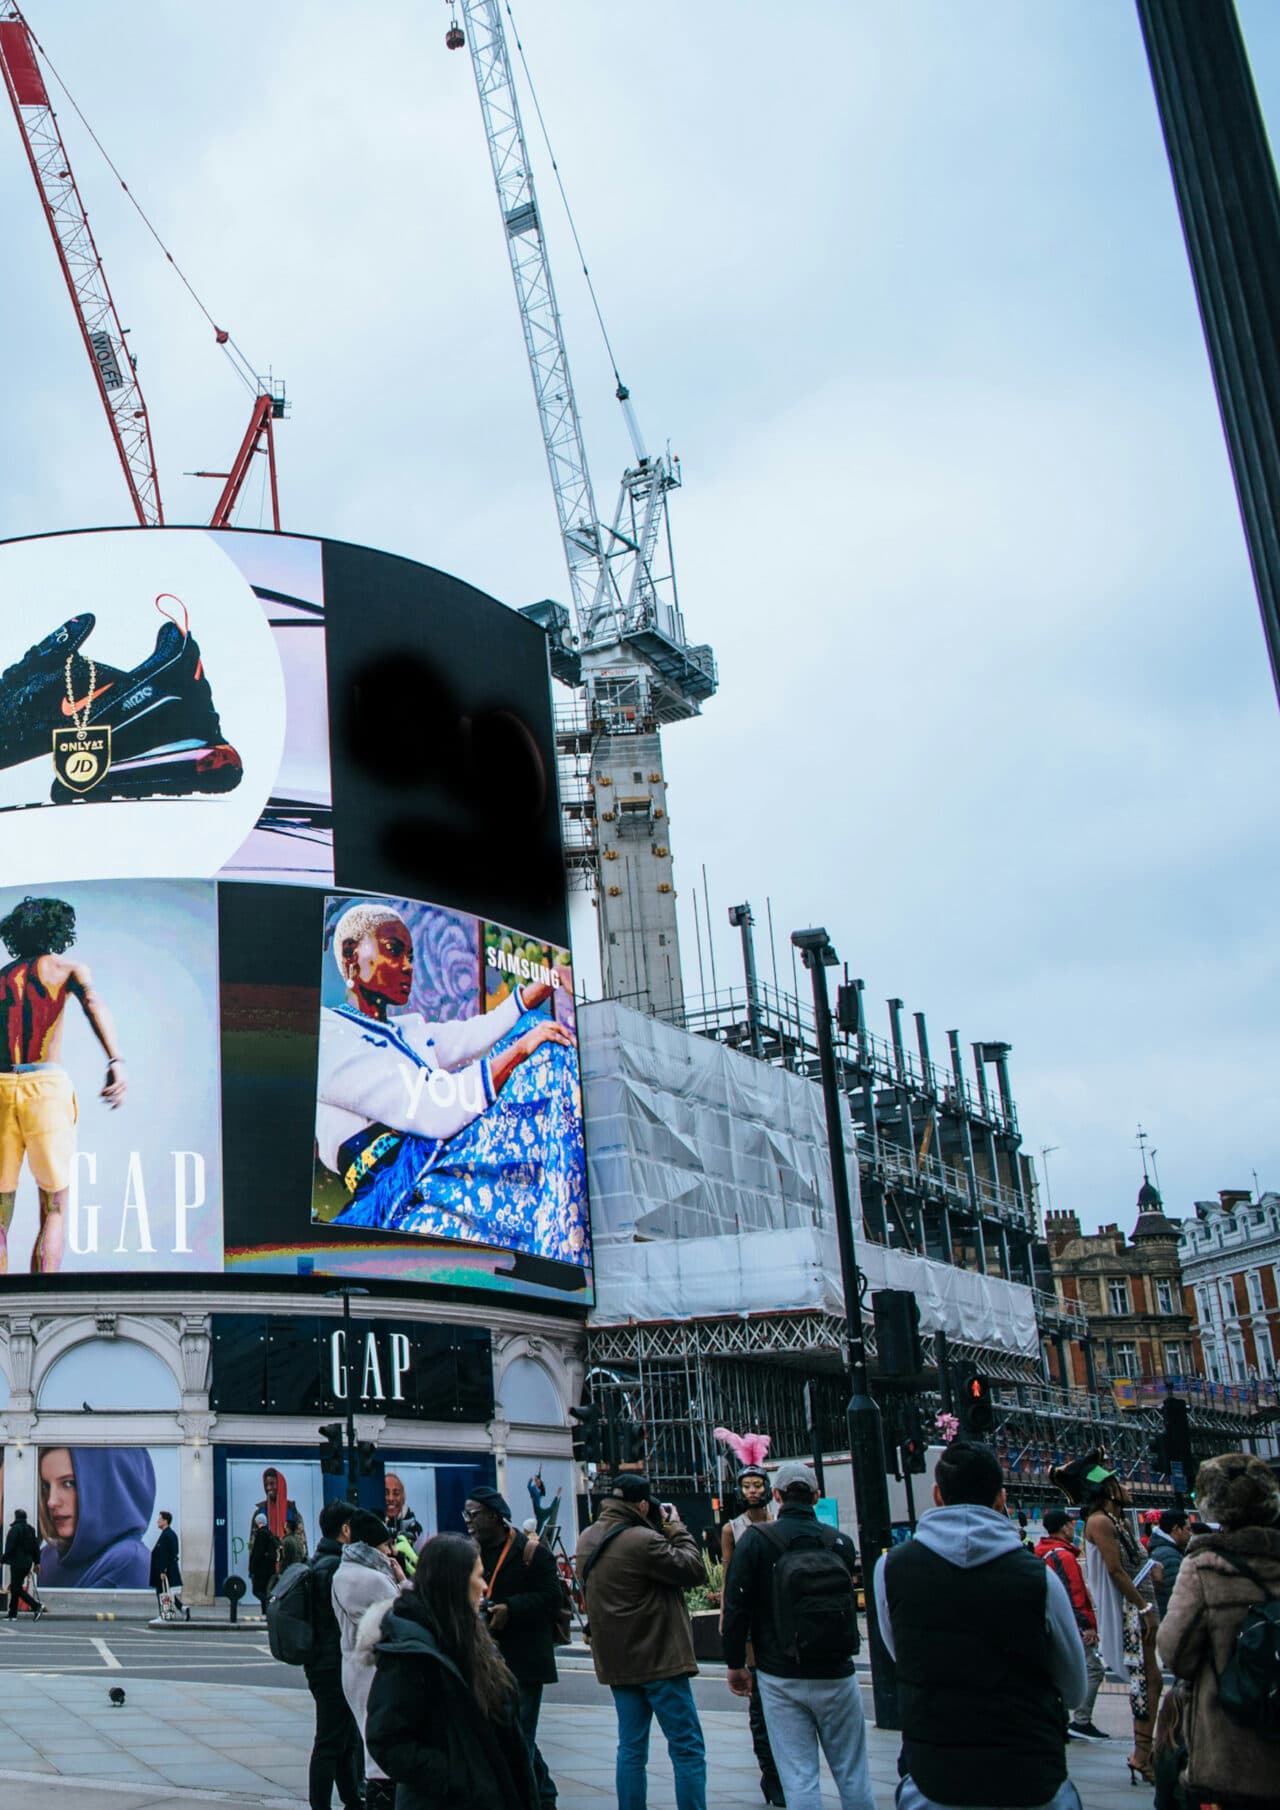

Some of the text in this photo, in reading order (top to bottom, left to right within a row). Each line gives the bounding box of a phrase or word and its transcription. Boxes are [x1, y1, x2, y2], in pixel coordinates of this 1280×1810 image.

[92, 336, 120, 388] WOLFF
[59, 740, 91, 752] ONLY
[70, 759, 93, 775] JD
[487, 945, 560, 990] SAMSUNG
[398, 1063, 483, 1120] you
[68, 1151, 206, 1255] GAP
[331, 1330, 410, 1400] GAP
